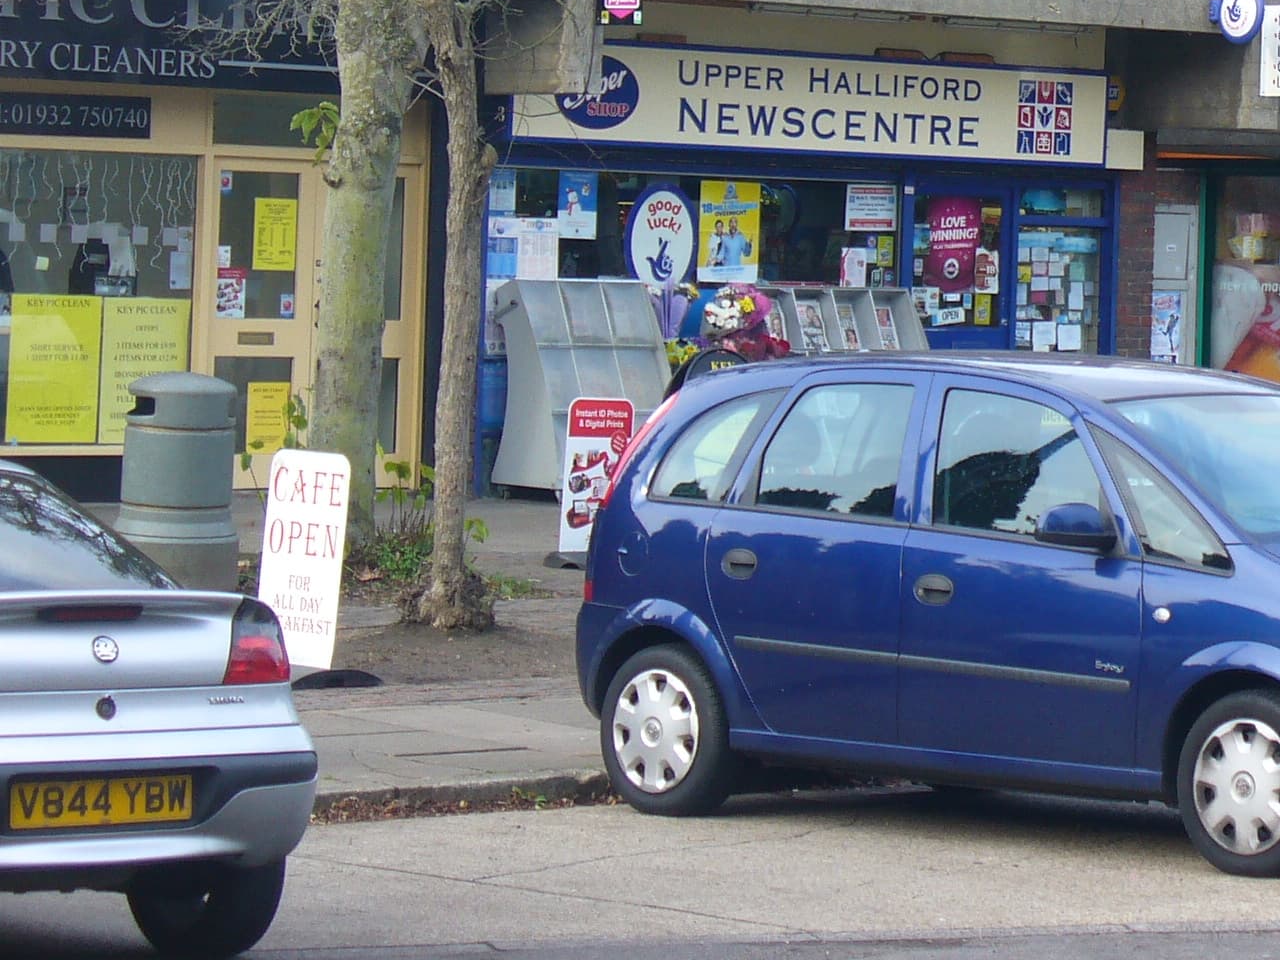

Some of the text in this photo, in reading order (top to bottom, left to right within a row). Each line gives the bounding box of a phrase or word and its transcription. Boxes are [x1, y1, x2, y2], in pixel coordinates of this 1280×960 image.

[50, 42, 215, 79] CLEANERS
[679, 61, 981, 102] UPPER HALLIFORD
[80, 107, 148, 129] 750740
[587, 102, 630, 117] SHOP
[678, 97, 980, 147] NEWSCENTRE
[647, 200, 682, 217] good
[702, 202, 713, 214] 18
[647, 217, 682, 234] luck!
[941, 216, 967, 228] LOVE
[930, 228, 979, 242] WINNING?
[941, 310, 960, 320] OPEN
[576, 409, 597, 417] Instant
[607, 410, 628, 418] Photos
[585, 419, 605, 429] Digital
[606, 420, 624, 428] Prints
[274, 466, 345, 507] CAFE
[269, 518, 339, 560] OPEN
[288, 574, 311, 593] FOR
[272, 593, 323, 615] ALL DAY
[276, 614, 332, 636] AKFAST
[18, 779, 187, 820] V844 YBW
